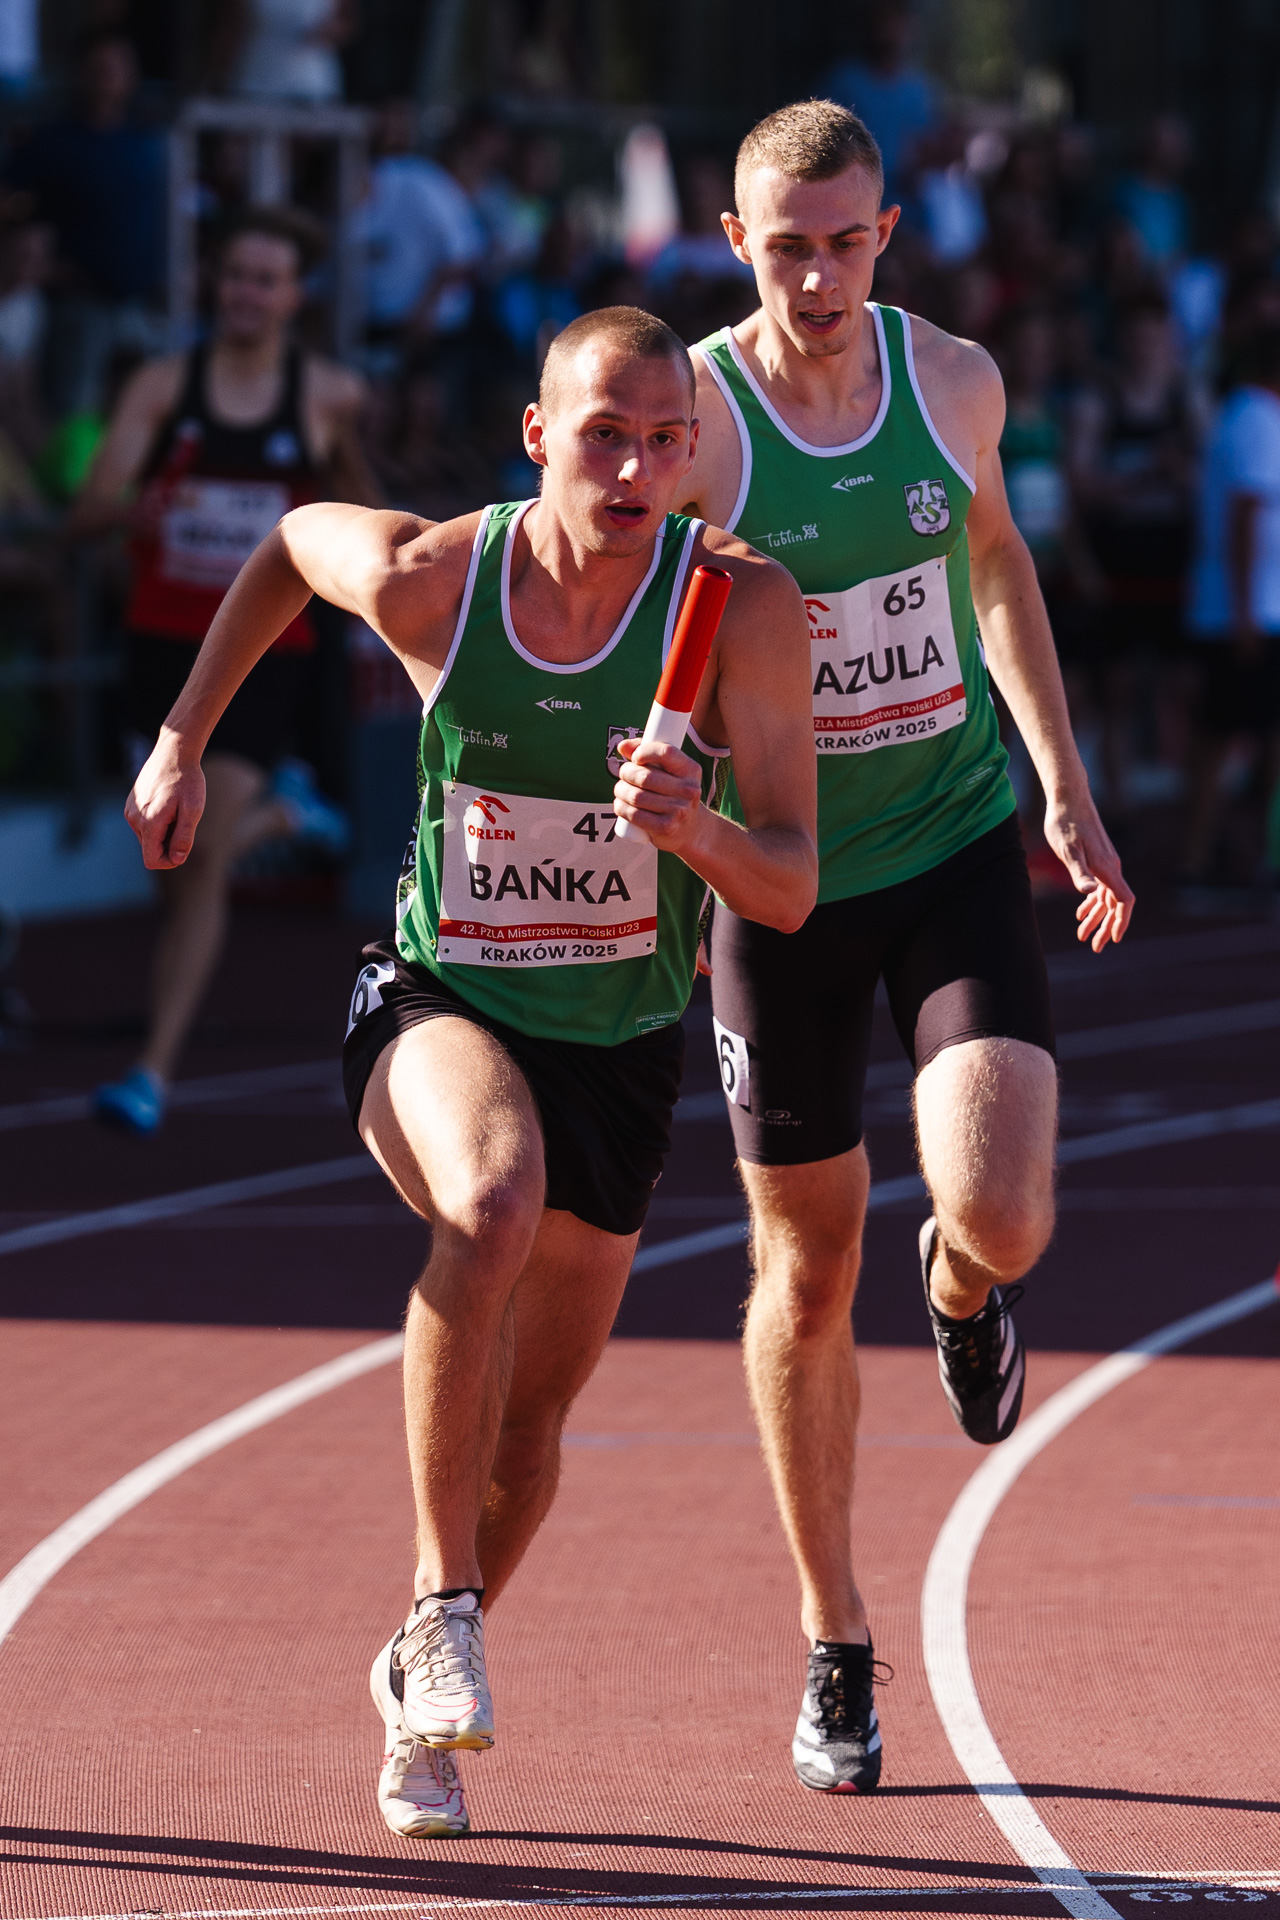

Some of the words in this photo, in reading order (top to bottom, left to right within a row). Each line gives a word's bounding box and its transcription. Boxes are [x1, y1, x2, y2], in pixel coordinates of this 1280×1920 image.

[845, 474, 874, 486] IBRA
[883, 575, 926, 616] 65
[810, 628, 838, 639] LEN
[812, 635, 945, 695] AZULA
[550, 699, 582, 711] IBRA
[814, 719, 835, 729] ZLA
[836, 709, 900, 728] Mistrzostwa
[902, 698, 933, 715] Polski
[934, 691, 952, 706] U23
[815, 727, 891, 749] KRAKÓW
[895, 716, 937, 738] 2025
[467, 824, 516, 841] ORLEN
[572, 812, 618, 843] 47
[469, 859, 632, 904] BAŃKA
[460, 924, 478, 936] 42.
[480, 926, 505, 940] PZLA
[507, 926, 579, 939] Mistrzostwa
[582, 926, 616, 937] Polski
[619, 922, 640, 934] U23
[481, 942, 567, 962] KRAKÓW
[572, 944, 618, 958] 2025
[720, 1034, 735, 1092] 6
